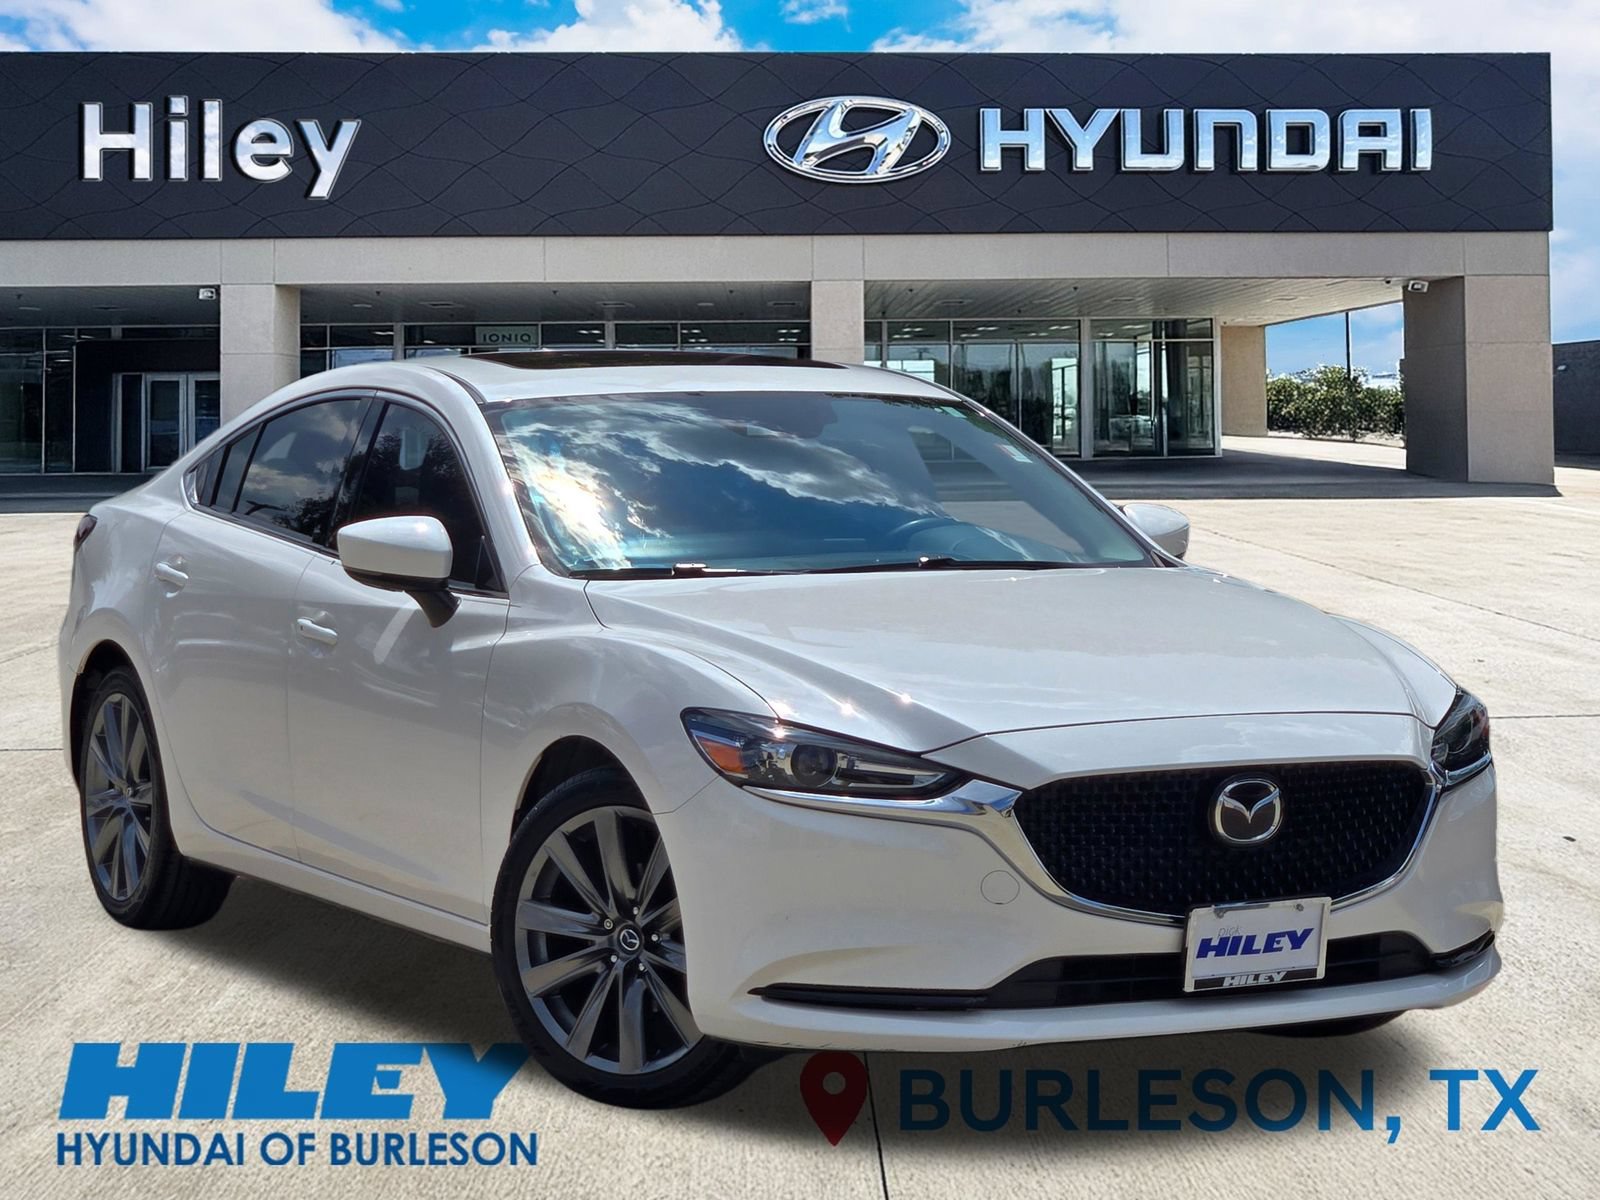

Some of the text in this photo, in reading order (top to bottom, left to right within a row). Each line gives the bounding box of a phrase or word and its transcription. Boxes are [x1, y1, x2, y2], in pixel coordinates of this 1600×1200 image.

[79, 95, 361, 199] Hiley
[979, 107, 1432, 172] HYUNDAI
[483, 333, 531, 343] IONIQ
[1196, 928, 1314, 958] HILEY
[1223, 971, 1288, 987] HILEY
